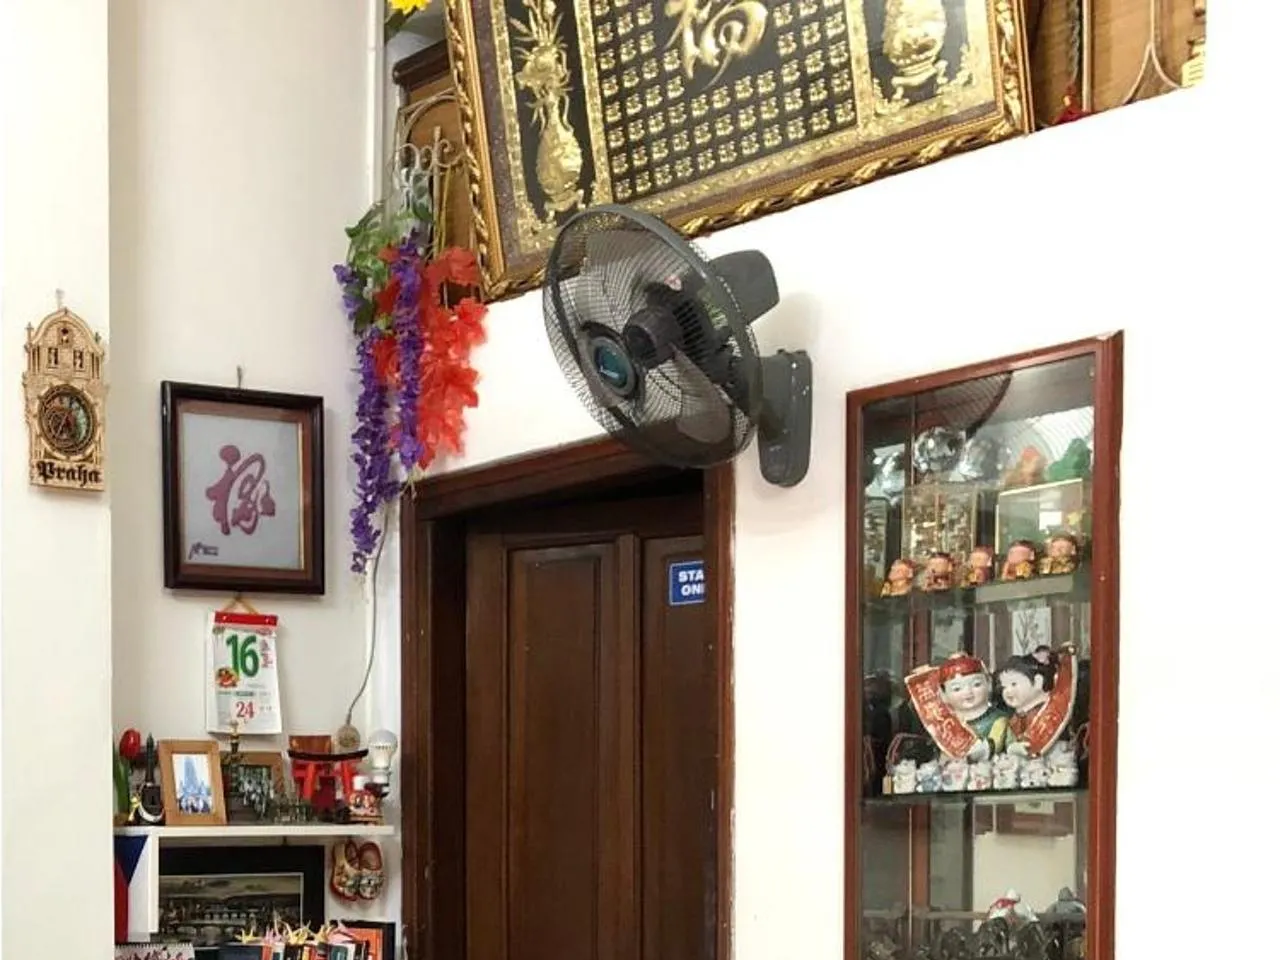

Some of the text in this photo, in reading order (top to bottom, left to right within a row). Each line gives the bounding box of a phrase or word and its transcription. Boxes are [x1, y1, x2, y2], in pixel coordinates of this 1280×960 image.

[37, 461, 101, 487] Praha
[678, 569, 704, 583] STA
[226, 634, 260, 678] 16
[236, 701, 255, 719] 24
